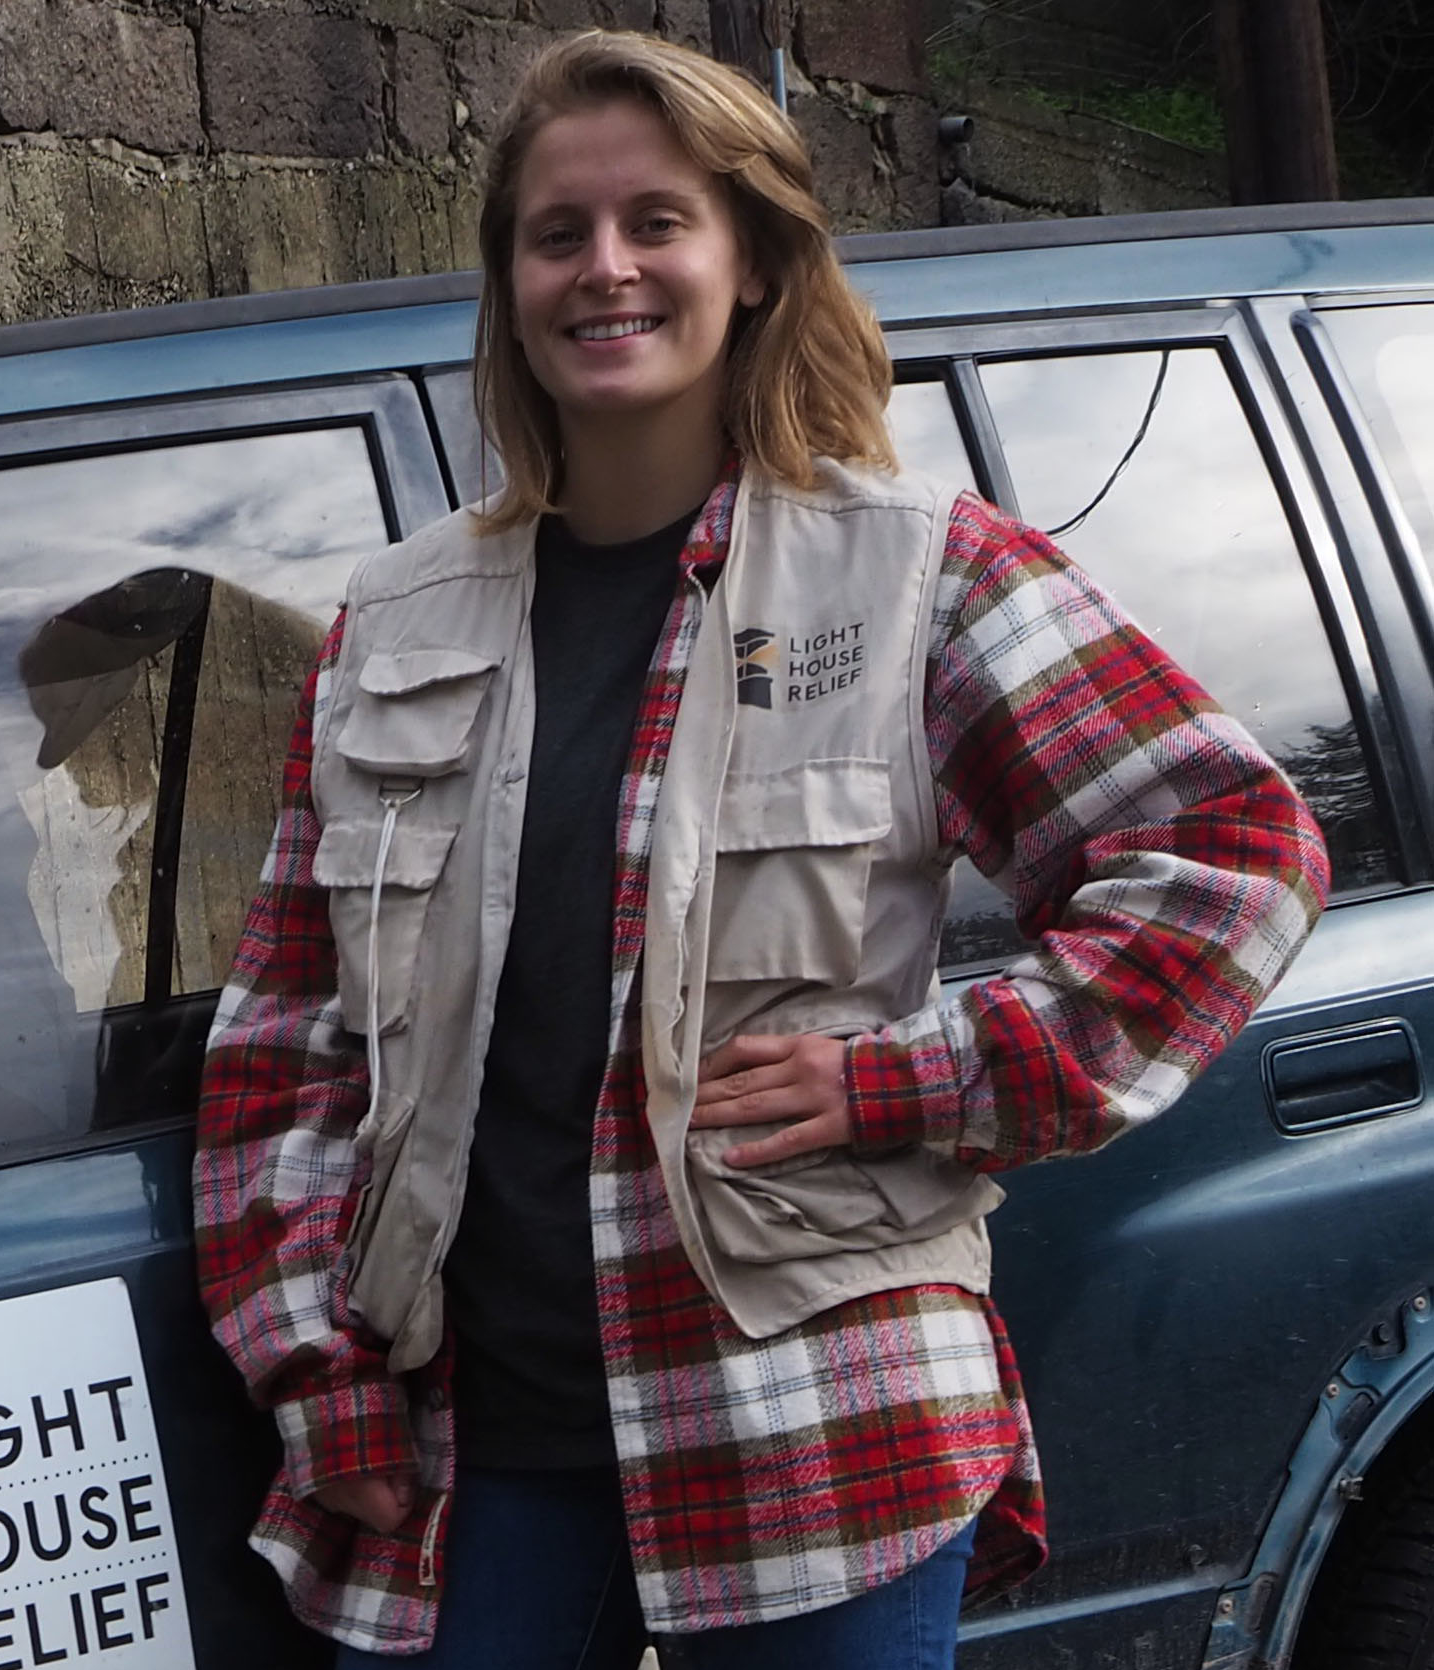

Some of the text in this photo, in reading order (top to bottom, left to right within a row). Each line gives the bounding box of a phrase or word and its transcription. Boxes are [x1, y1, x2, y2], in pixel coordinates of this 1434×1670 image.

[790, 623, 864, 654] LIGHT
[789, 646, 864, 677] HOUSE
[788, 668, 863, 702] RELIEF
